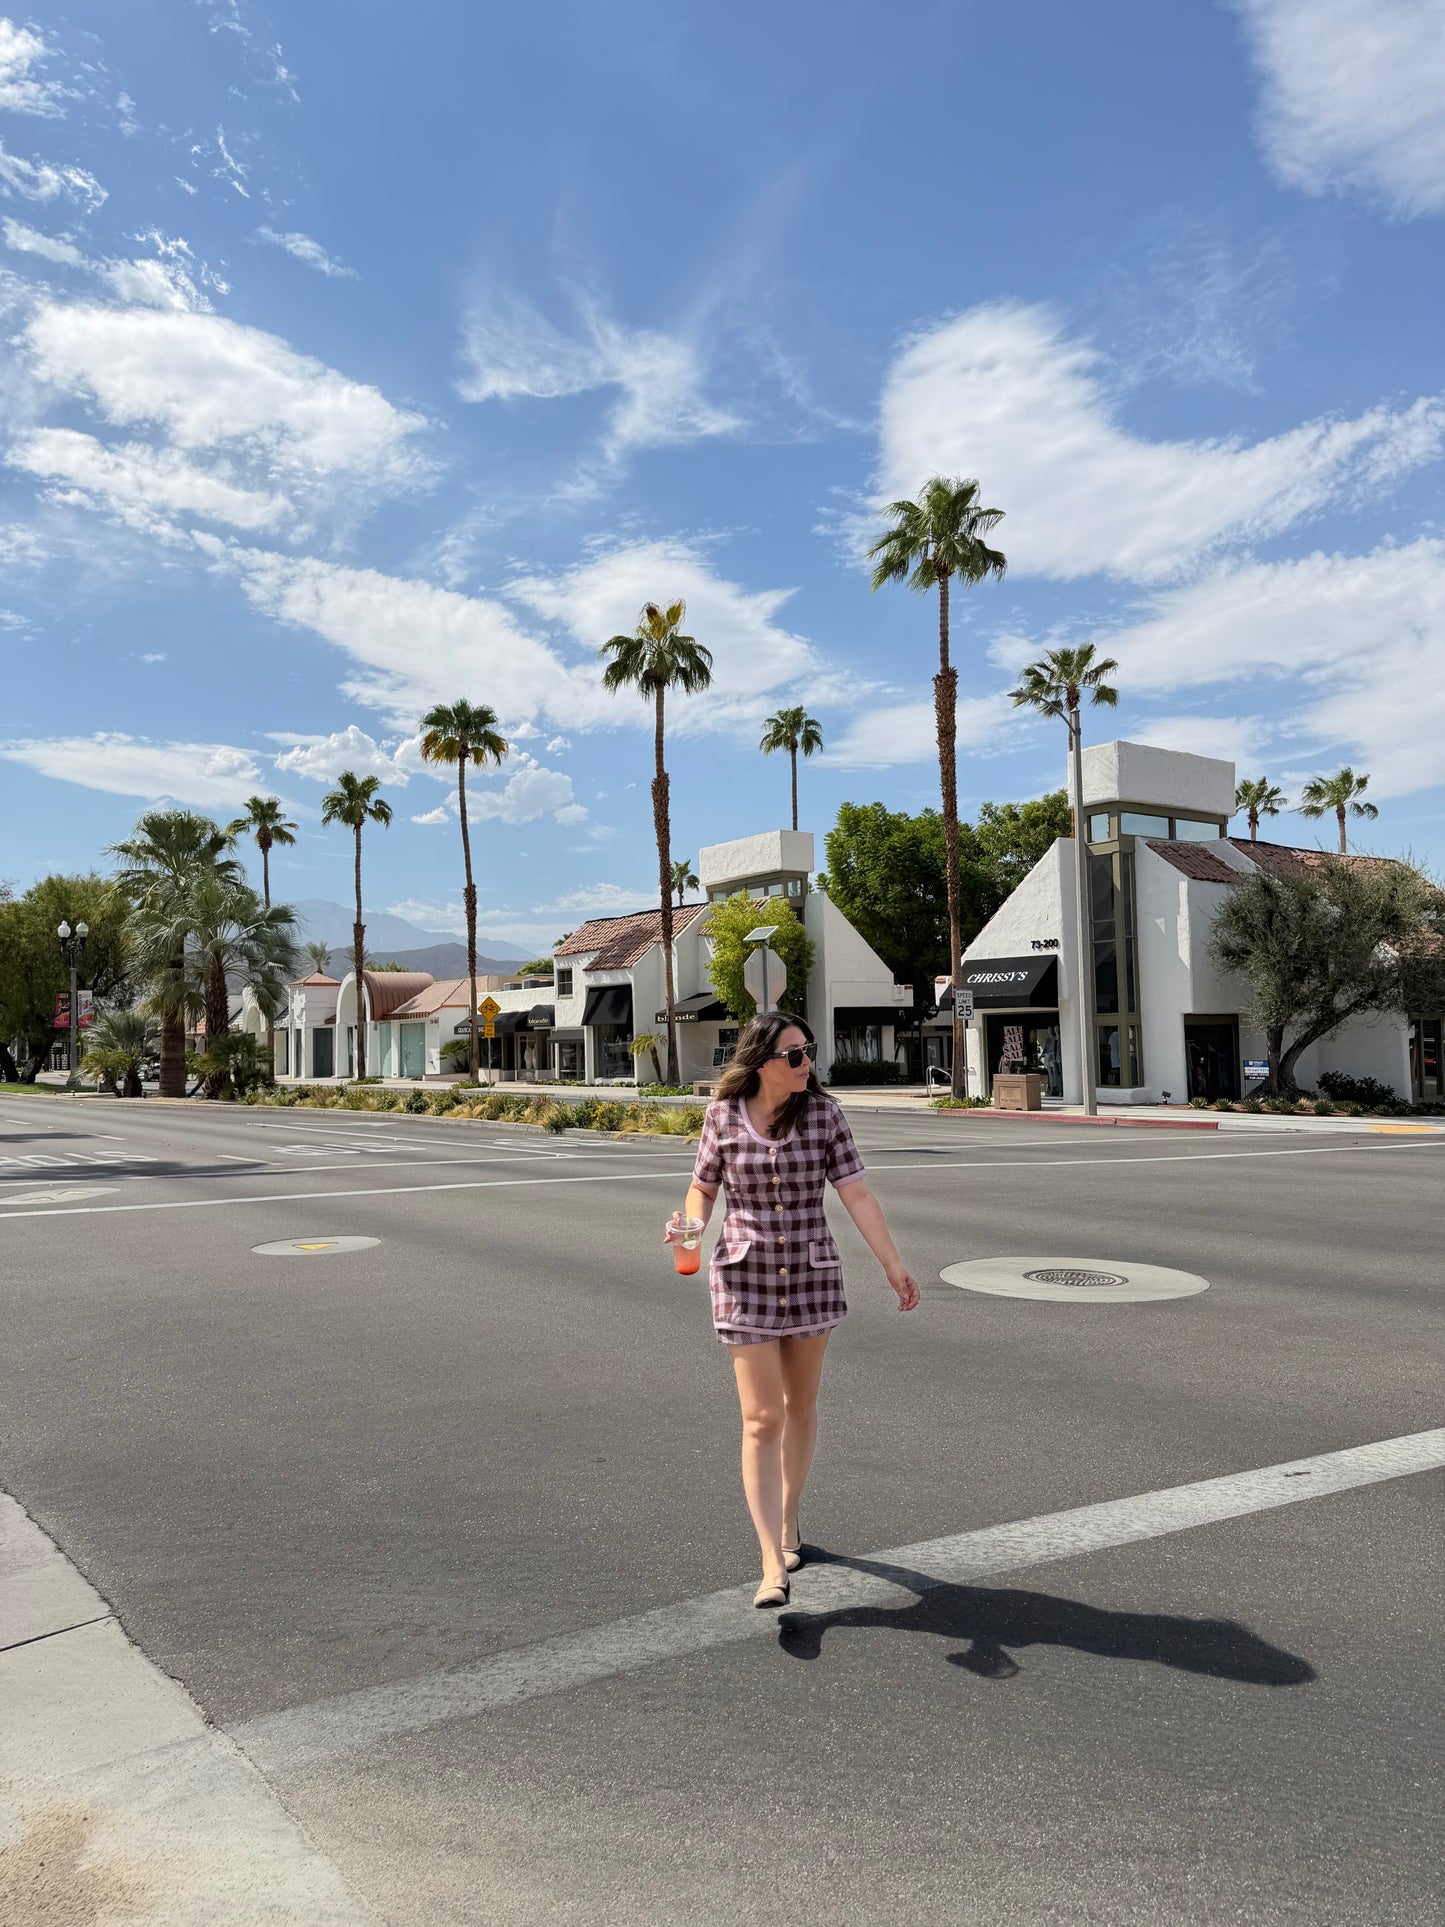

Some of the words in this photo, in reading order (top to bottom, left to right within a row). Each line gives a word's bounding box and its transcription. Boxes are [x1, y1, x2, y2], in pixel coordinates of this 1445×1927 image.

[1031, 939, 1059, 949] 73-200
[966, 971, 1028, 984] CHRISSY'S
[958, 1005, 972, 1017] 25
[657, 1013, 696, 1022] blnde
